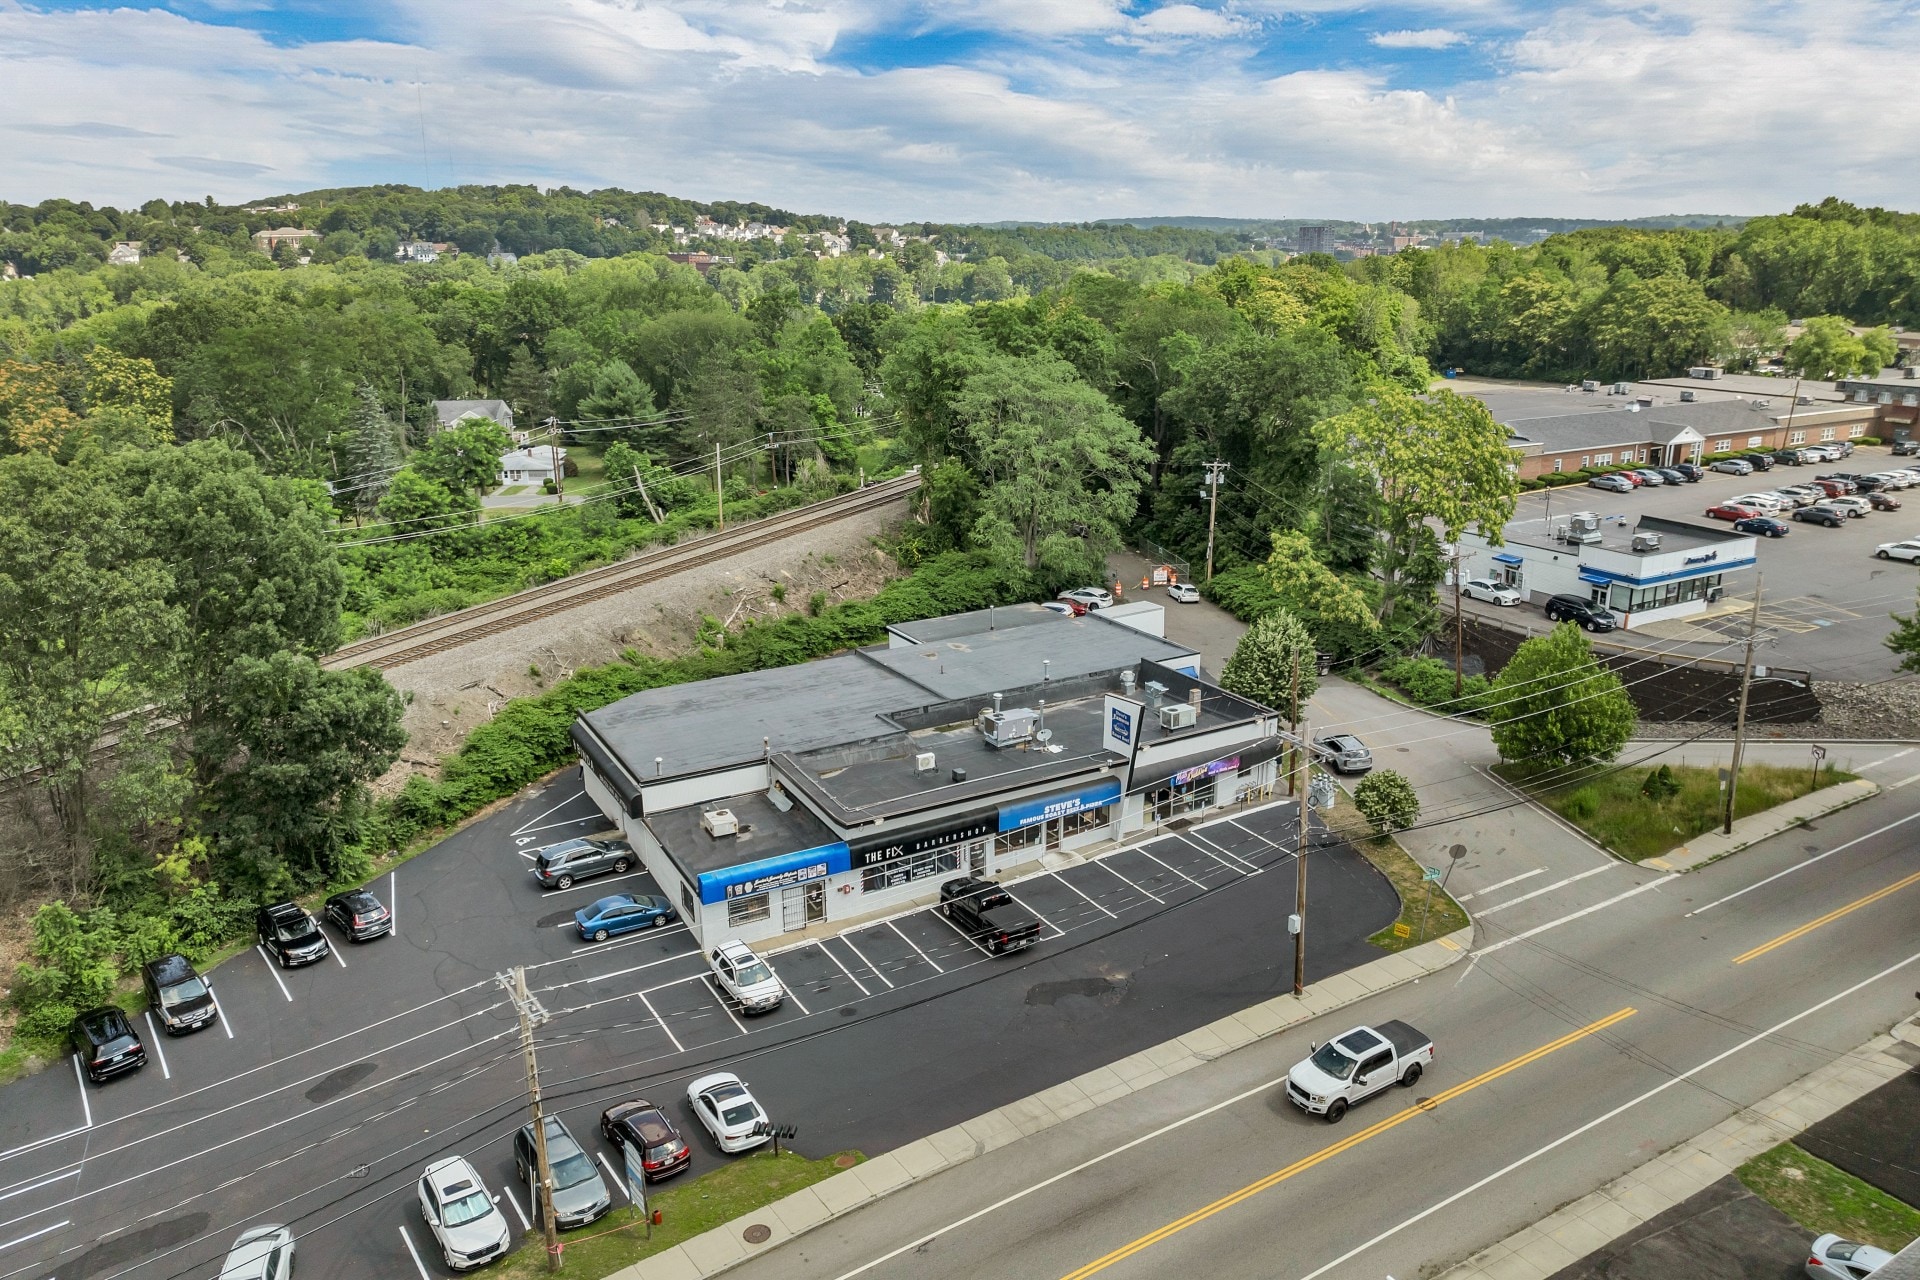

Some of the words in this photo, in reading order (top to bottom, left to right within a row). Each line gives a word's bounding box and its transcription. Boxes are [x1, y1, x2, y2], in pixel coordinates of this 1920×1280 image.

[1044, 798, 1081, 814] STEVE'S
[1020, 814, 1045, 825] FAMOUS
[1046, 810, 1066, 819] ROAST
[865, 850, 883, 864] THE
[886, 845, 904, 859] FIX
[916, 826, 987, 850] BARBERSHOP
